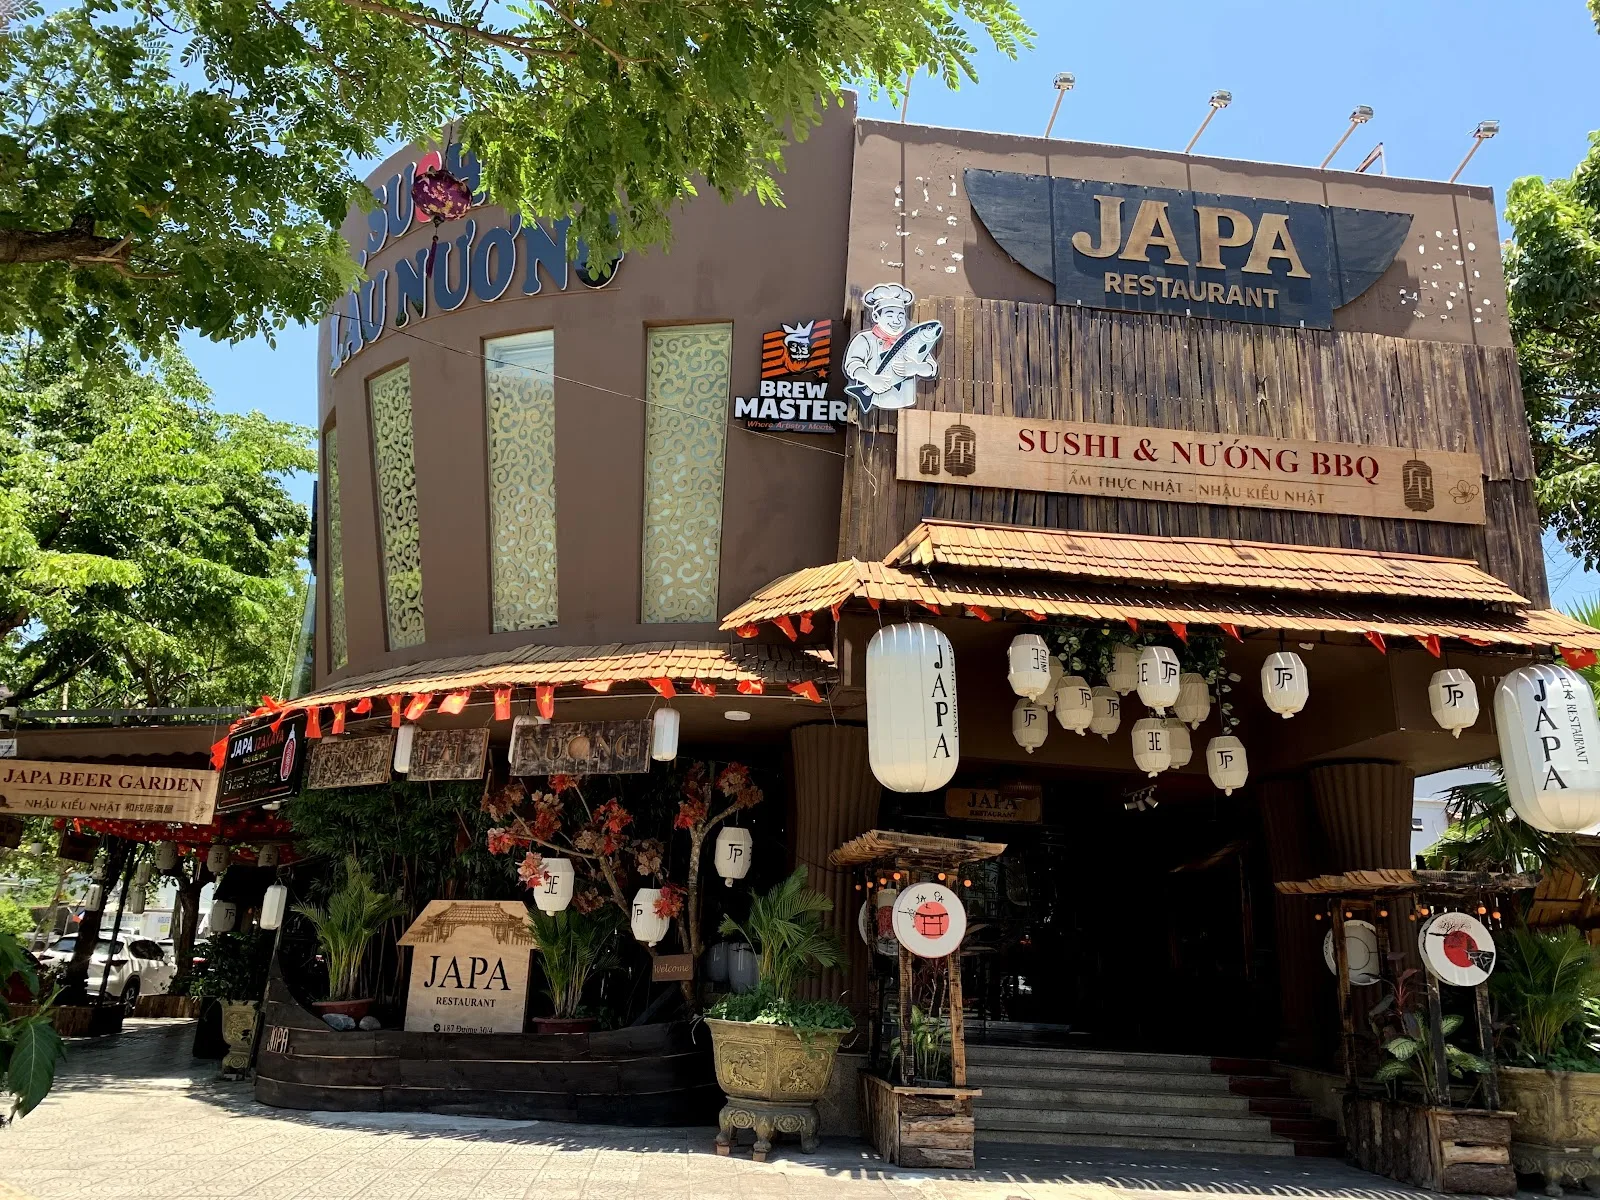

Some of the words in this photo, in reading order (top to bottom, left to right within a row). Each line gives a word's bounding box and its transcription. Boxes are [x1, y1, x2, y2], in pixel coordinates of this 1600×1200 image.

[1071, 194, 1311, 279] JAPA
[1104, 272, 1280, 309] RESTAURANT
[760, 380, 828, 399] BREW
[735, 397, 847, 422] MASTER
[776, 421, 806, 431] Artistry
[1018, 428, 1122, 459] SUSHI
[1133, 438, 1159, 462] &
[1170, 438, 1299, 473] NƯỚNG
[1310, 451, 1380, 485] BBQ
[1097, 476, 1138, 491] THỰC
[1142, 479, 1183, 495] NHẬT
[1199, 484, 1241, 500] NHẬU
[1246, 483, 1280, 501] KIỂU
[1284, 489, 1325, 506] NHẬT
[931, 644, 950, 759] JAPA
[230, 735, 253, 759] JAPA
[1534, 679, 1569, 790] JAPA
[1566, 703, 1589, 765] RESTAURANT
[3, 768, 53, 785] JAPA
[57, 771, 112, 788] BEER
[118, 774, 205, 793] GARDEN
[90, 801, 121, 814] NHẬT
[423, 955, 512, 991] JAPA
[436, 996, 497, 1008] RESTAURANT
[443, 1024, 455, 1032] 187
